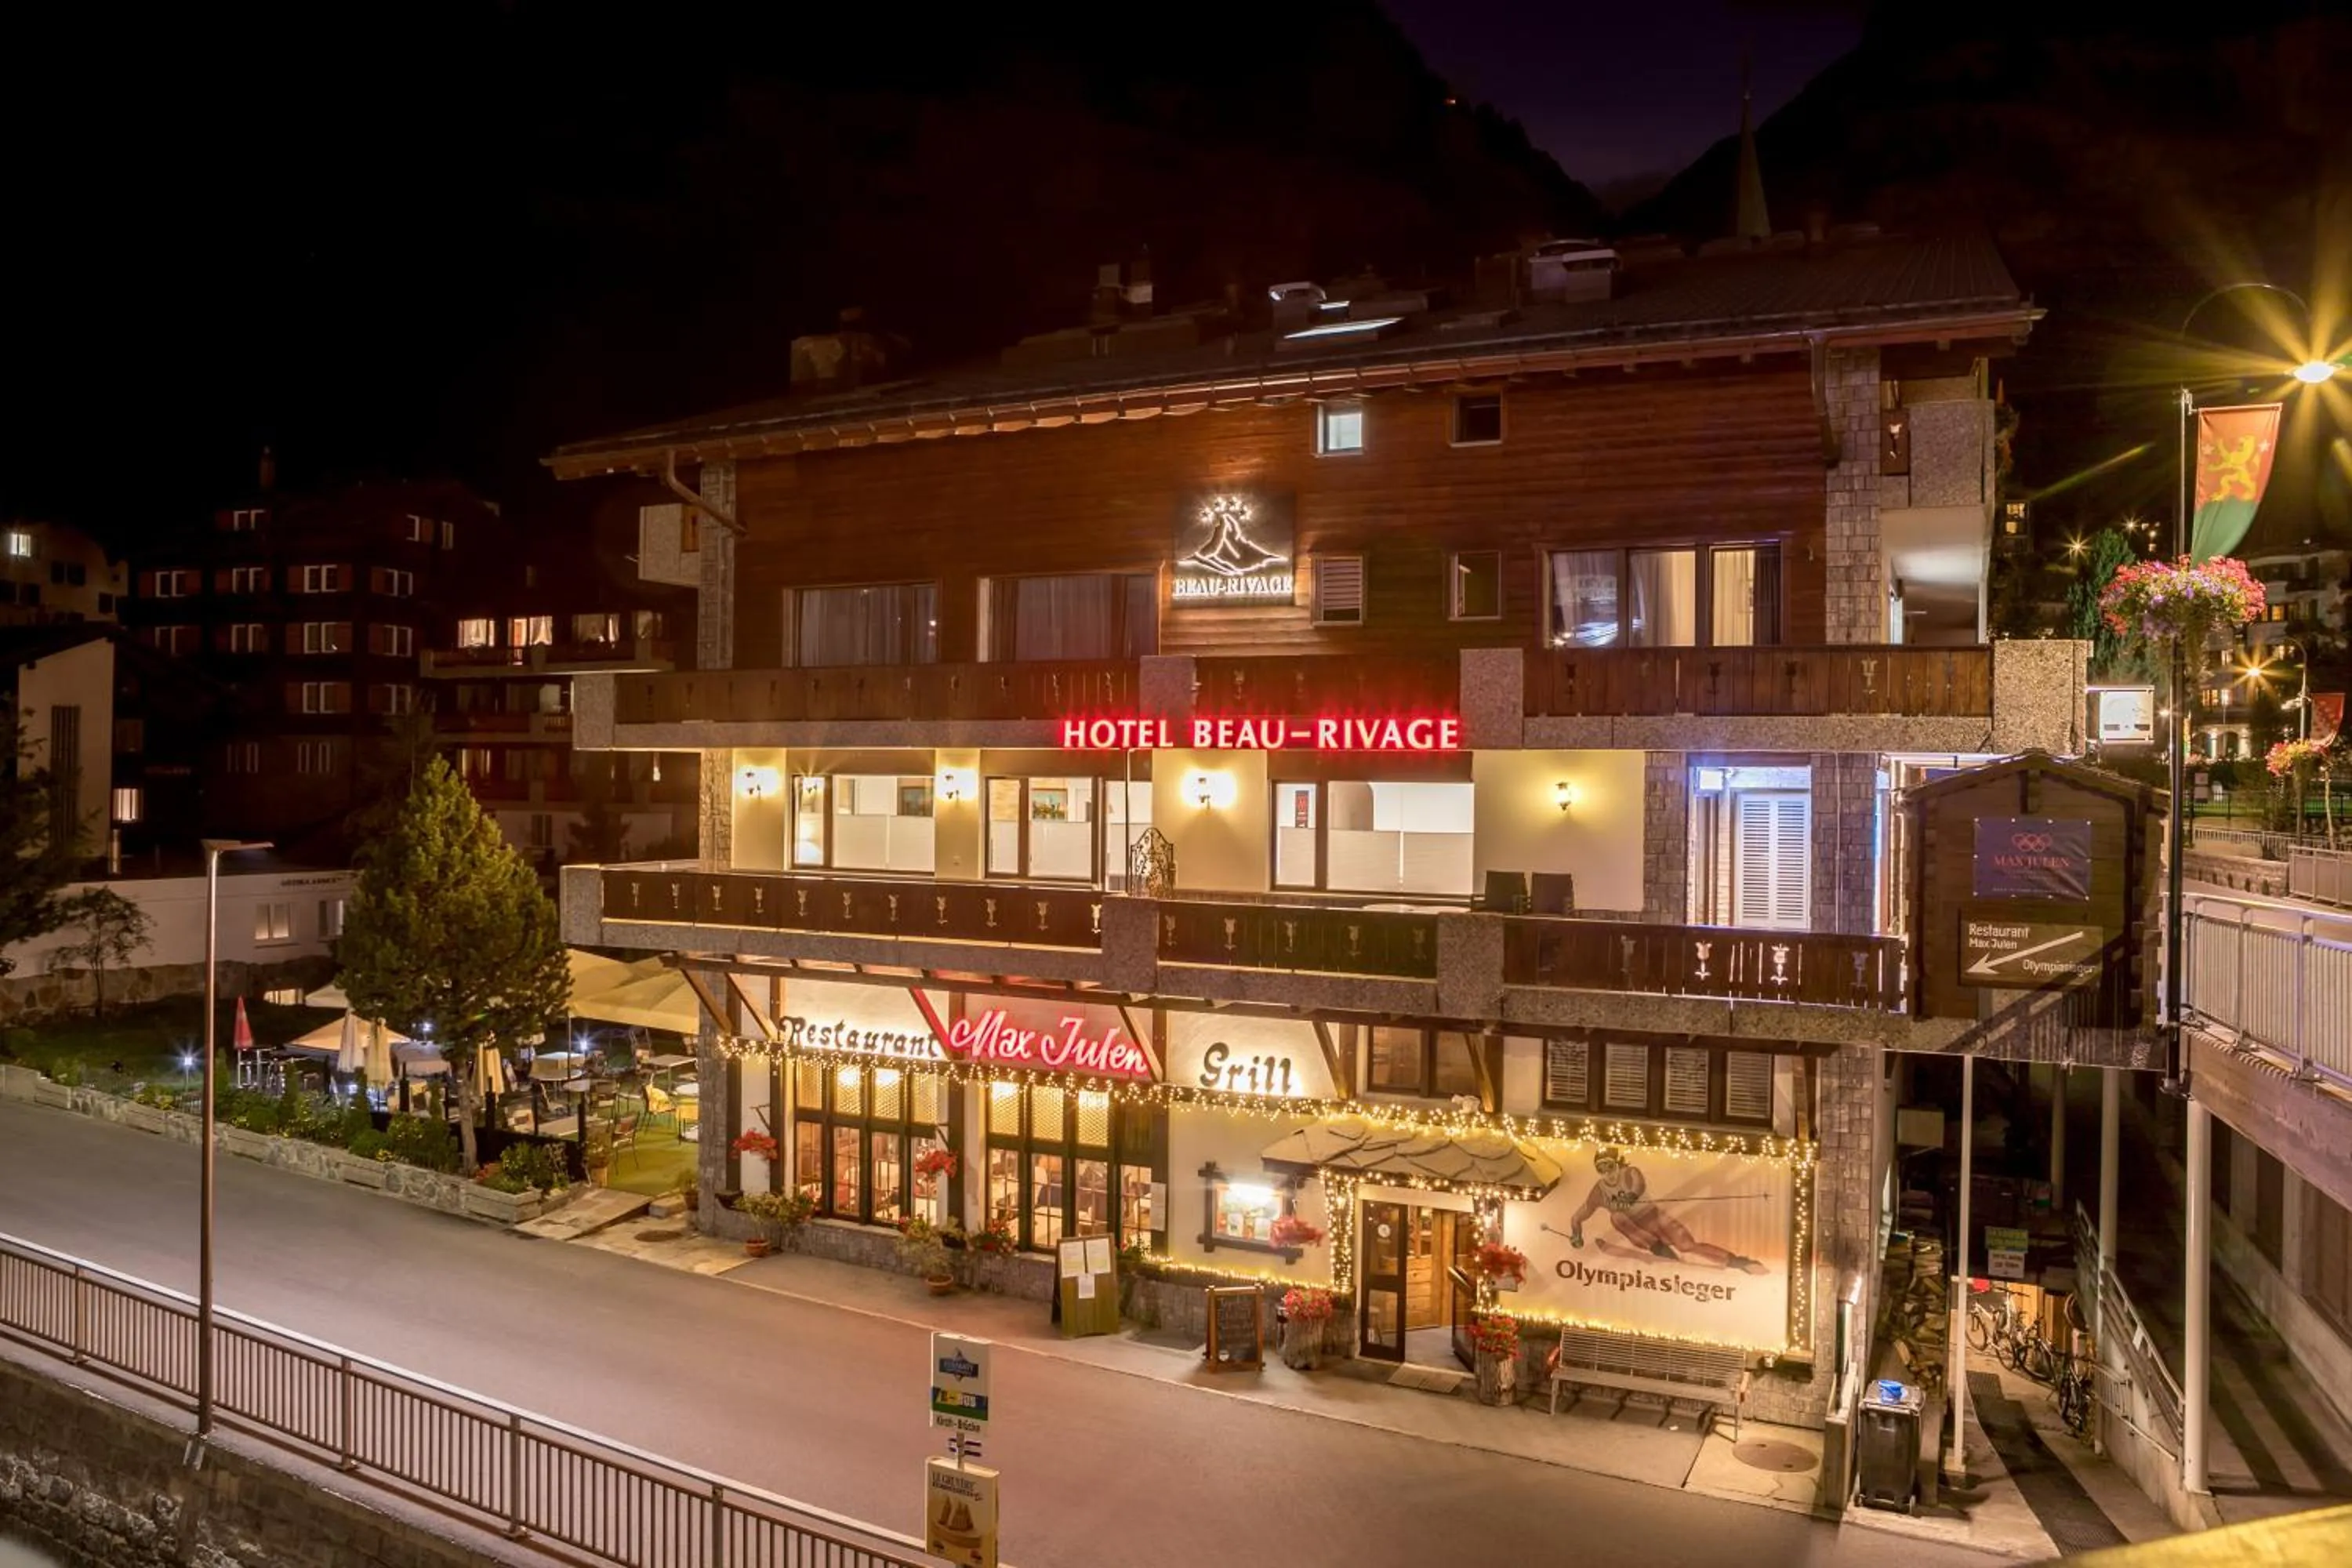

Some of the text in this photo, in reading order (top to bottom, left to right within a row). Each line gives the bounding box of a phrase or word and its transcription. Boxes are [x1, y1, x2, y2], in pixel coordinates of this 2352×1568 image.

[1173, 575, 1294, 598] BEAU-RIVAGE
[1063, 719, 1458, 750] HOTEL BEAU-RIVAGE
[1994, 855, 2071, 869] MAX JULEN
[1969, 923, 2031, 938] Restaurant
[1969, 938, 2017, 949] Max Julen
[779, 1010, 1291, 1094] Restaurant Max Julen Grill
[1555, 1259, 1737, 1302] Olympiasieger
